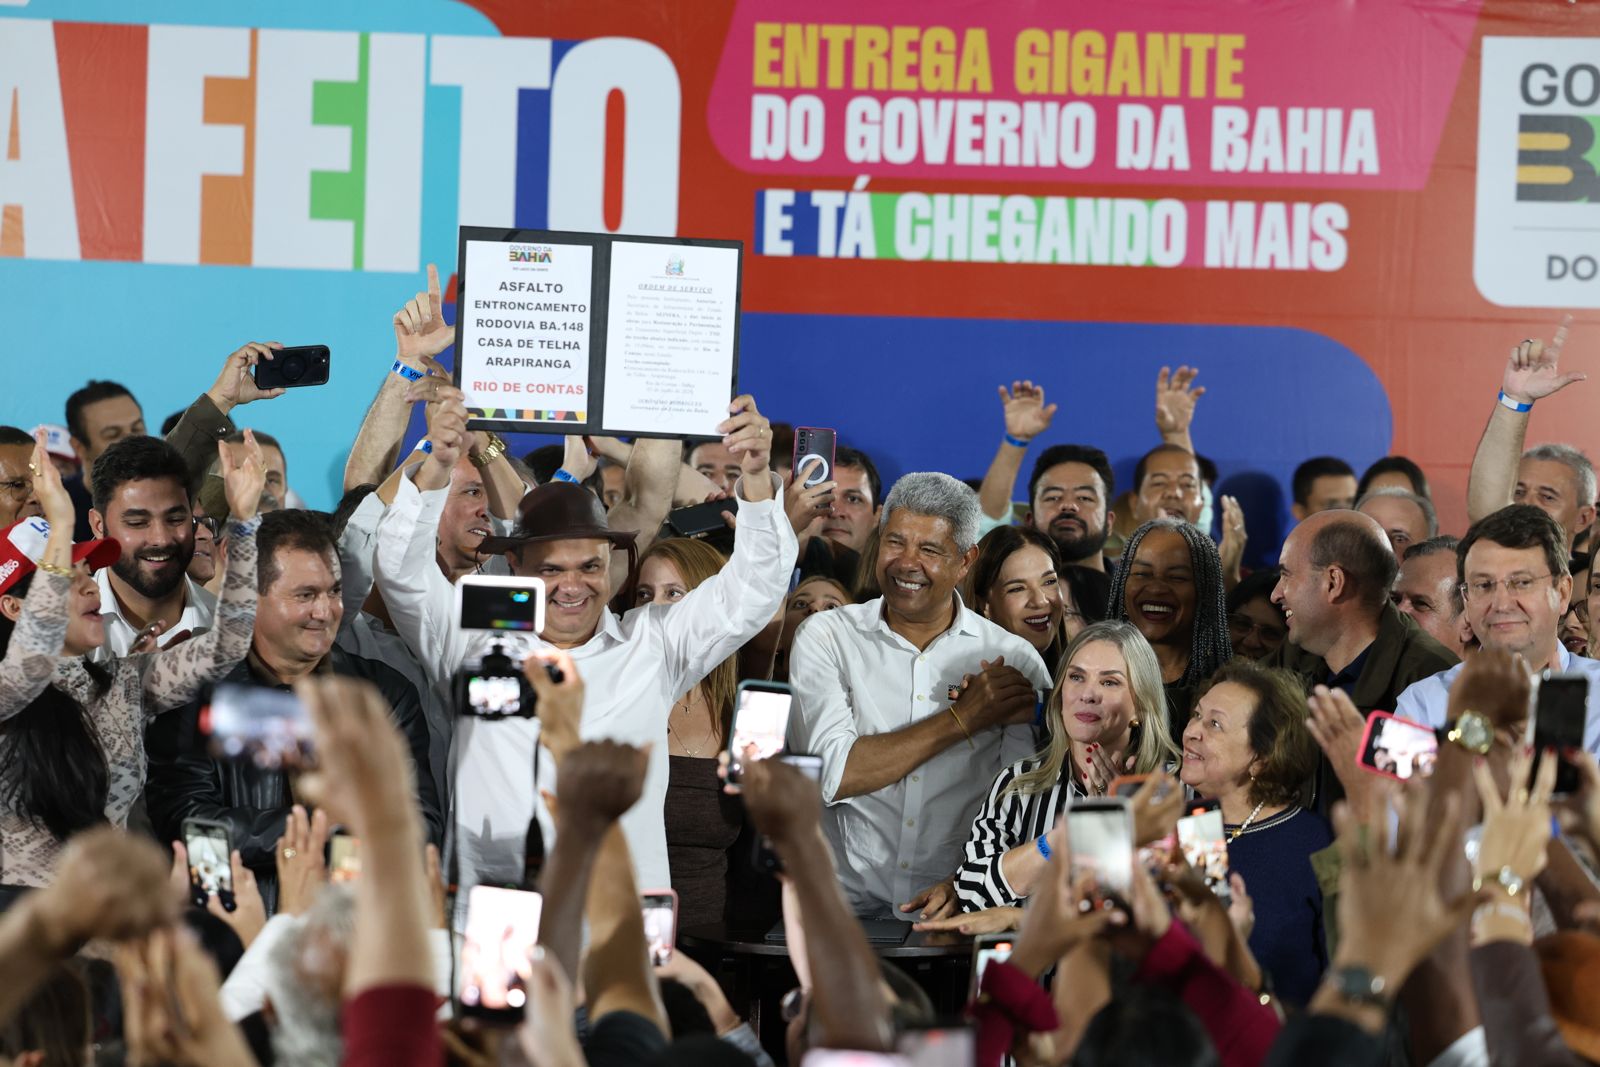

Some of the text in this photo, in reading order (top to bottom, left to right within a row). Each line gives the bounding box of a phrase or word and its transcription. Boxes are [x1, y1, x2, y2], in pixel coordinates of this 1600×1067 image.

[754, 23, 1246, 99] ENTREGA GIGANTE
[751, 94, 1380, 175] DO GOVERNO DA BAHIA
[142, 24, 682, 273] FEITO
[763, 175, 1349, 272] E TÁ CHEGANDO MAIS
[509, 251, 552, 263] BAHIA
[1546, 255, 1598, 281] DO
[499, 281, 563, 294] ASFALTO
[638, 283, 665, 292] ORDEM
[475, 300, 587, 313] ENTRONCAMENTO
[476, 318, 584, 332] RODOVIA BA.148
[478, 337, 581, 350] CASA DE TELHA
[486, 357, 571, 369] ARAPIRANGA
[473, 381, 584, 395] RIO DE CONTAS
